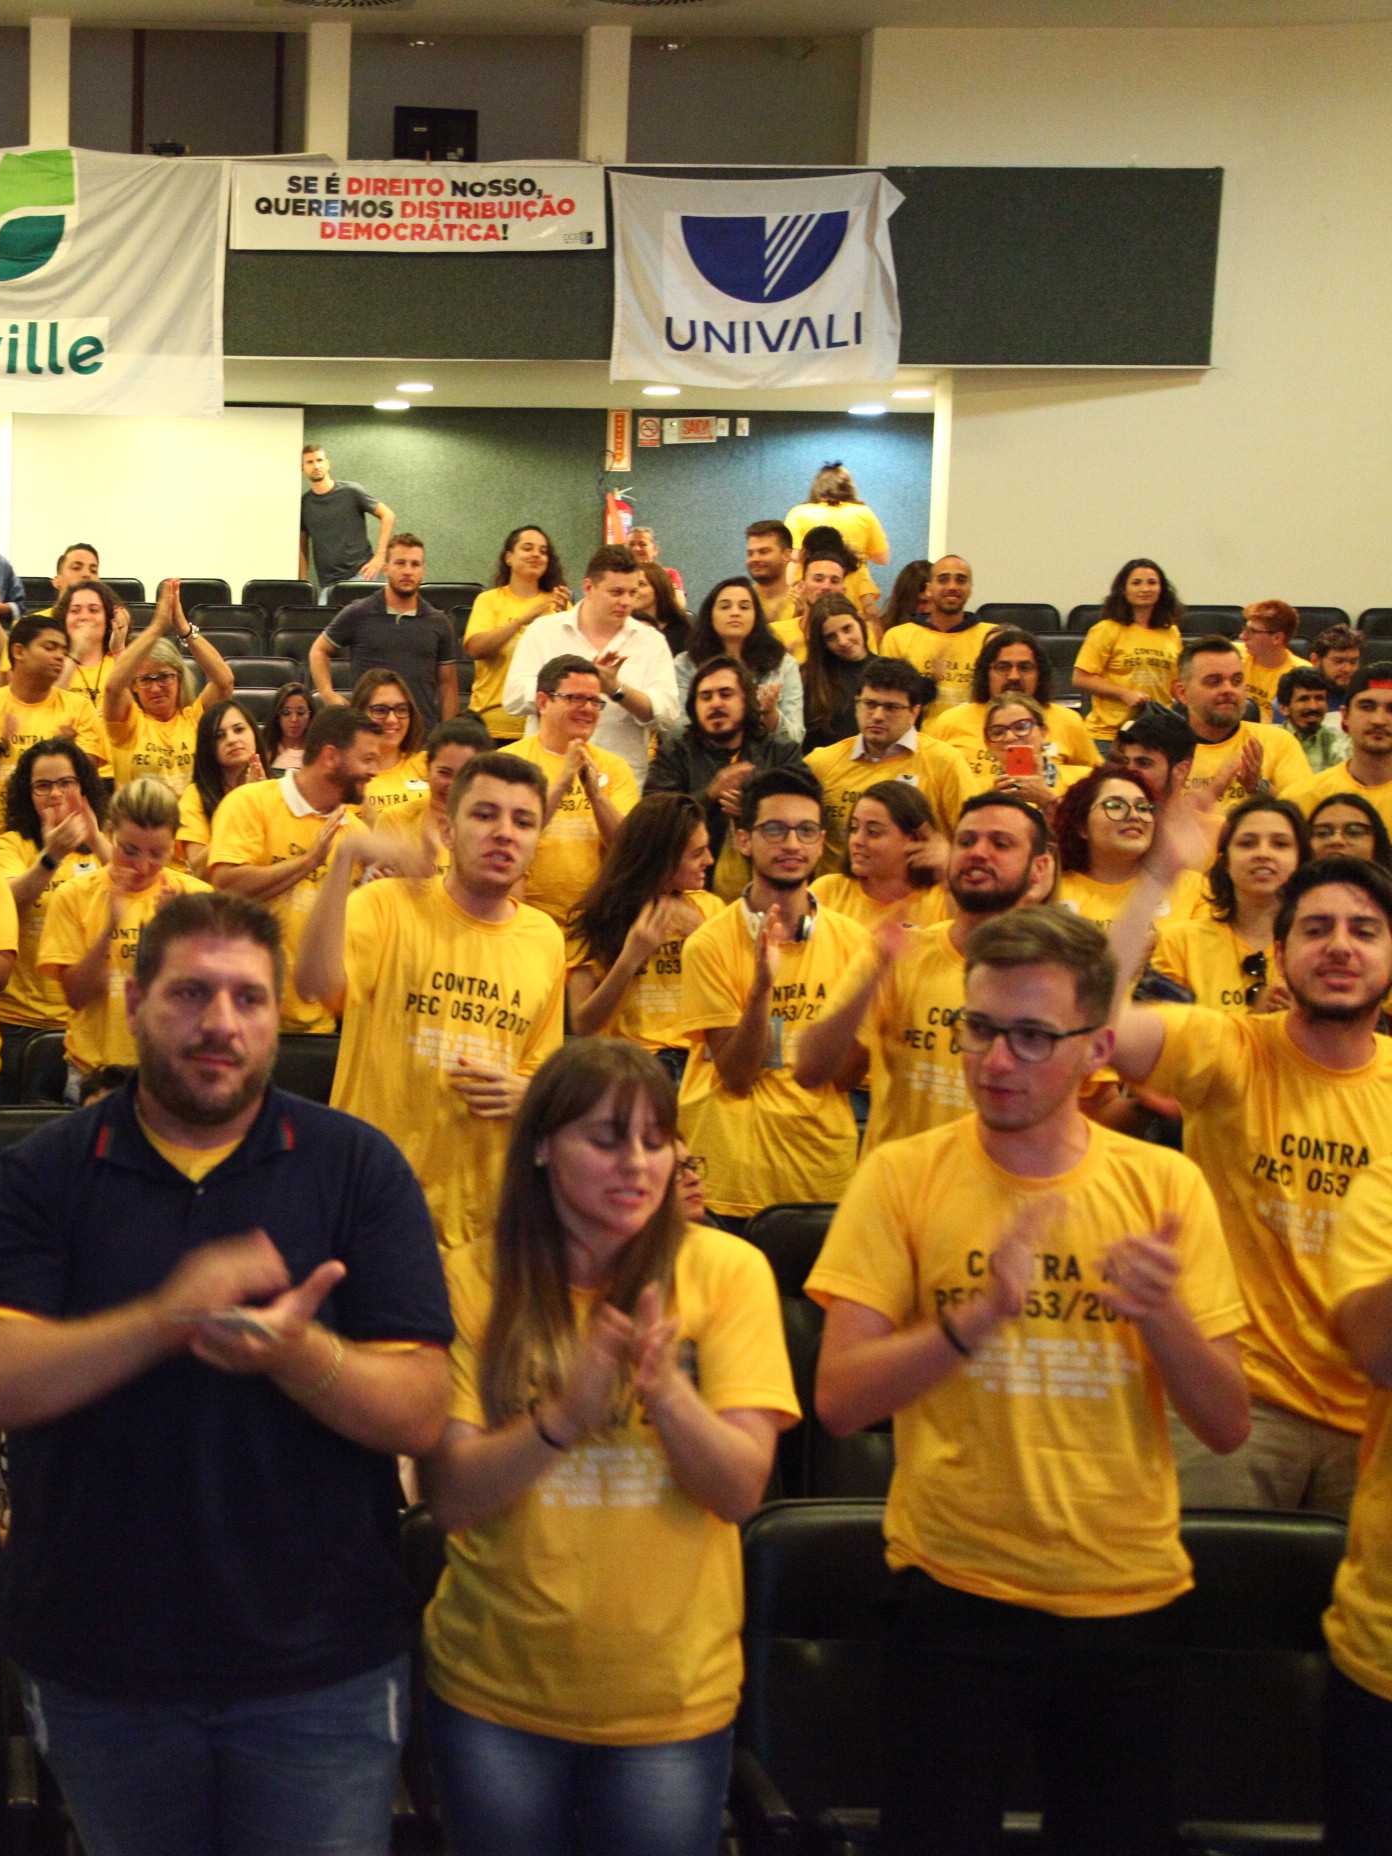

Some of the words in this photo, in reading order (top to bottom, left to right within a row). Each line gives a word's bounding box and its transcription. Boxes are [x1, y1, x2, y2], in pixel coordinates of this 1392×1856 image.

[287, 175, 318, 195] SE
[325, 171, 341, 195] É
[346, 177, 445, 197] DIREITO
[450, 177, 543, 199] NOSSO,
[254, 196, 394, 219] QUEREMOS
[399, 194, 576, 222] DISTRIBUIÇÃO
[319, 219, 509, 242] DEMOCRÁTICA!
[665, 311, 862, 353] UNIVALI
[369, 792, 408, 806] ONTRA
[656, 959, 682, 975] 053
[432, 971, 500, 1001] CONTRA
[511, 989, 521, 1008] A
[772, 985, 807, 999] NTRA
[815, 983, 826, 999] A
[405, 992, 441, 1016] PEC
[1281, 1133, 1369, 1169] CONTRA
[1253, 1153, 1293, 1186] PEC
[1307, 1168, 1351, 1198] 053
